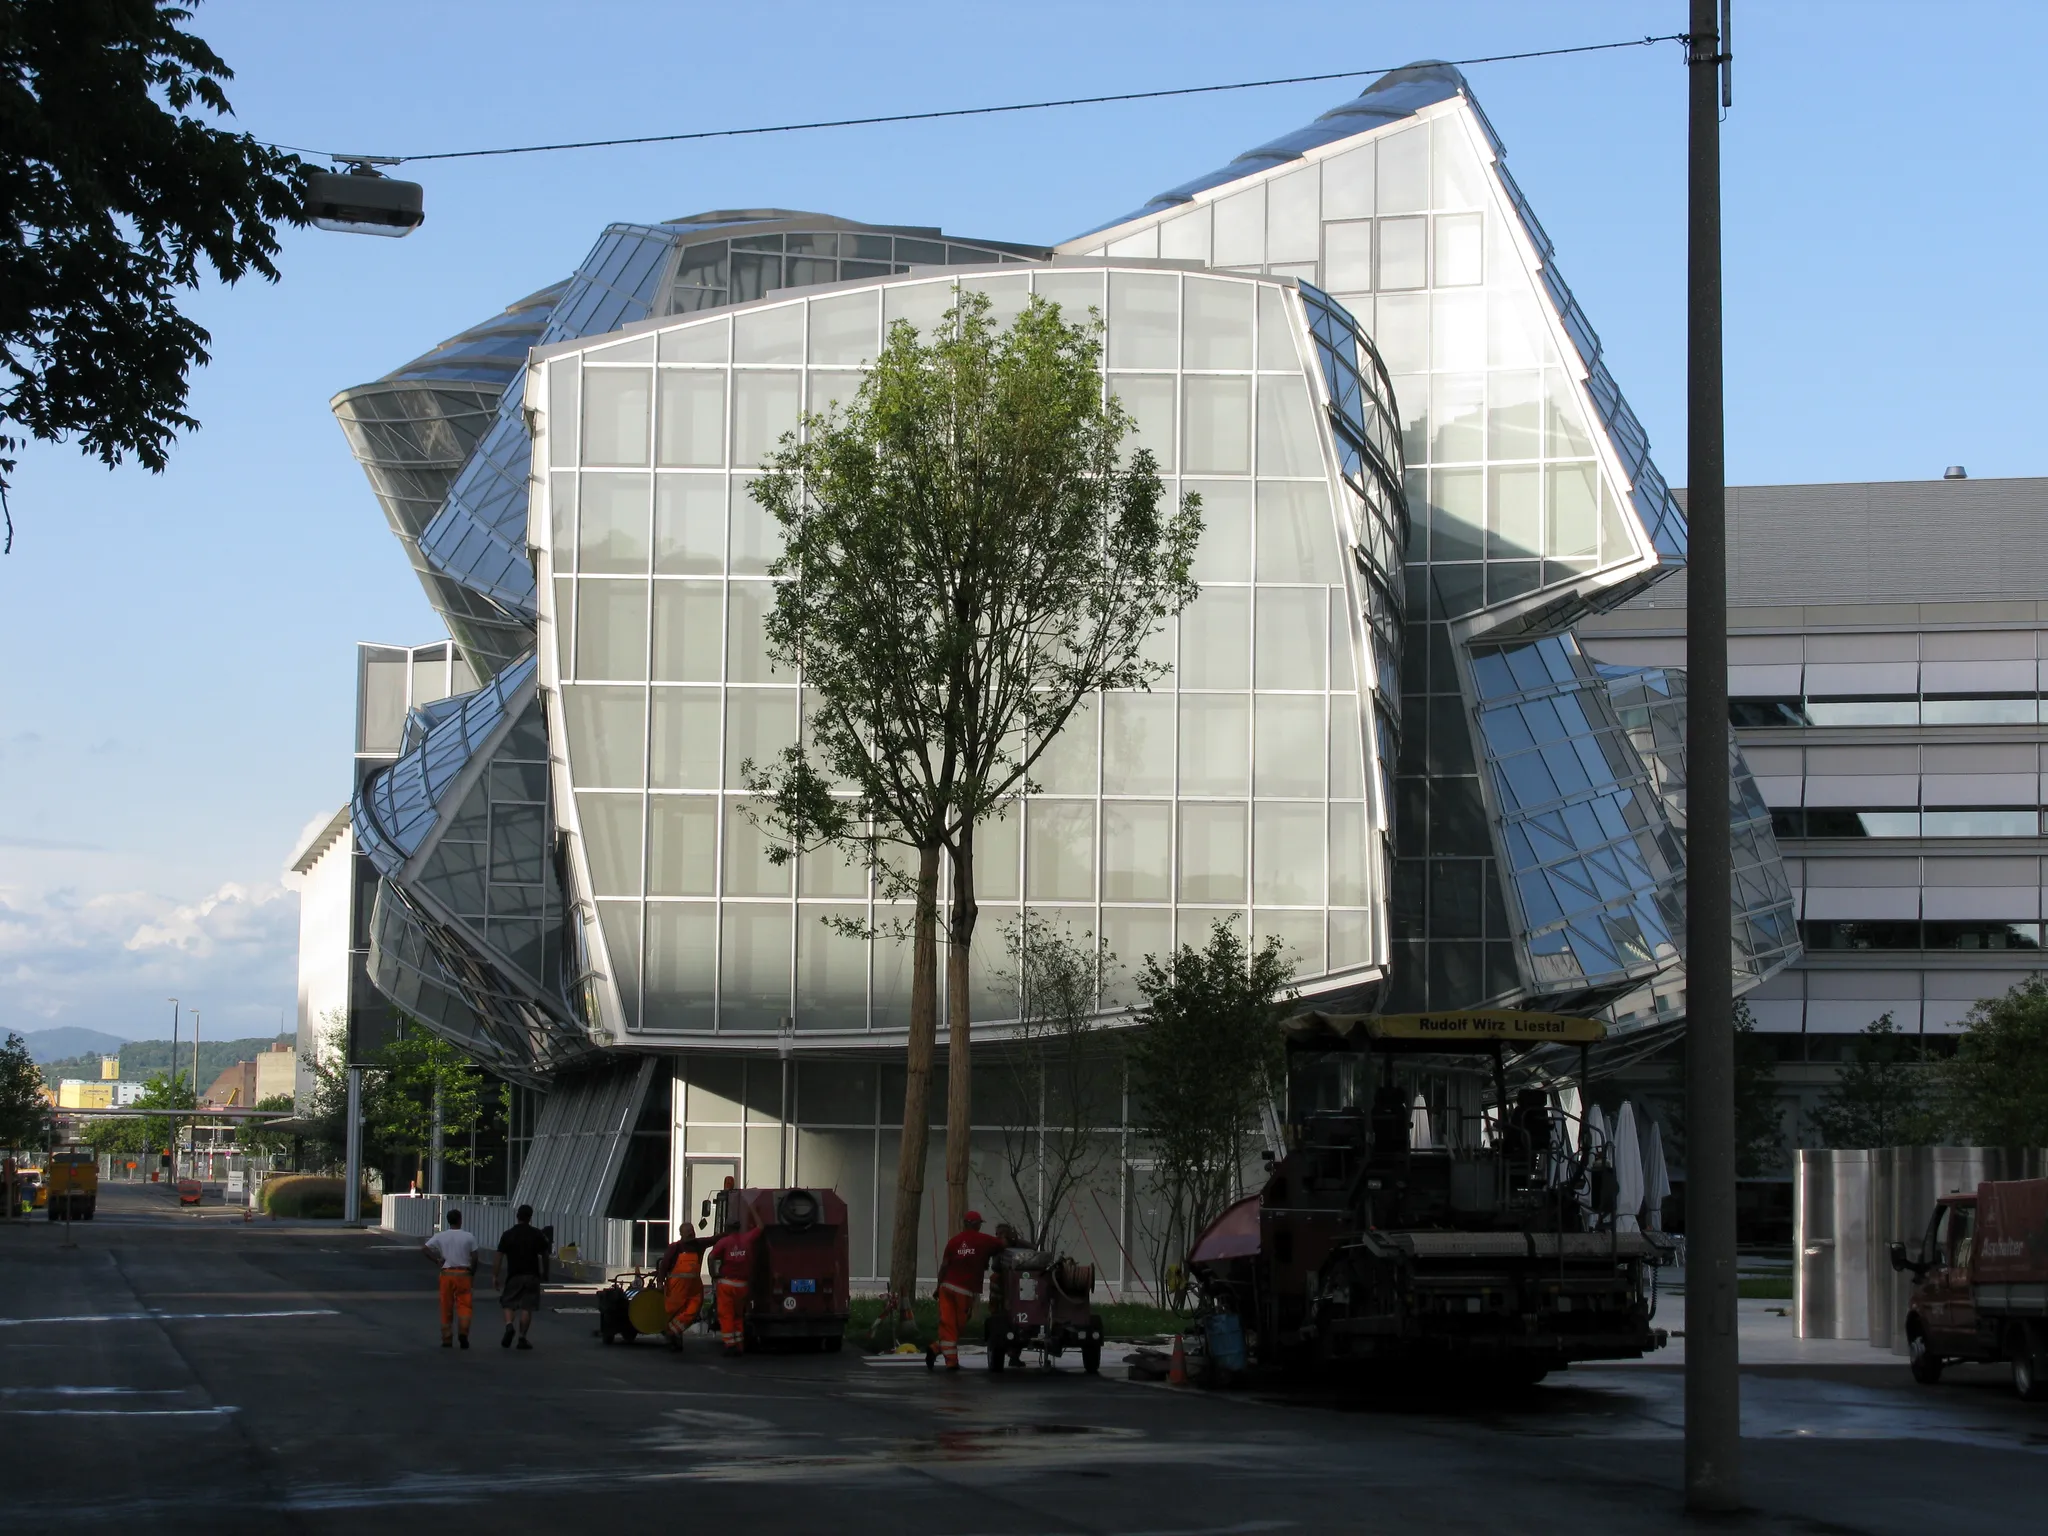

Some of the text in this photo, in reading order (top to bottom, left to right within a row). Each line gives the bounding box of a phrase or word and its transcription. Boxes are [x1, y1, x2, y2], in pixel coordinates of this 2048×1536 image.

[1419, 1018, 1565, 1032] Rudolf Wirz Liestal
[1016, 1312, 1029, 1323] 12
